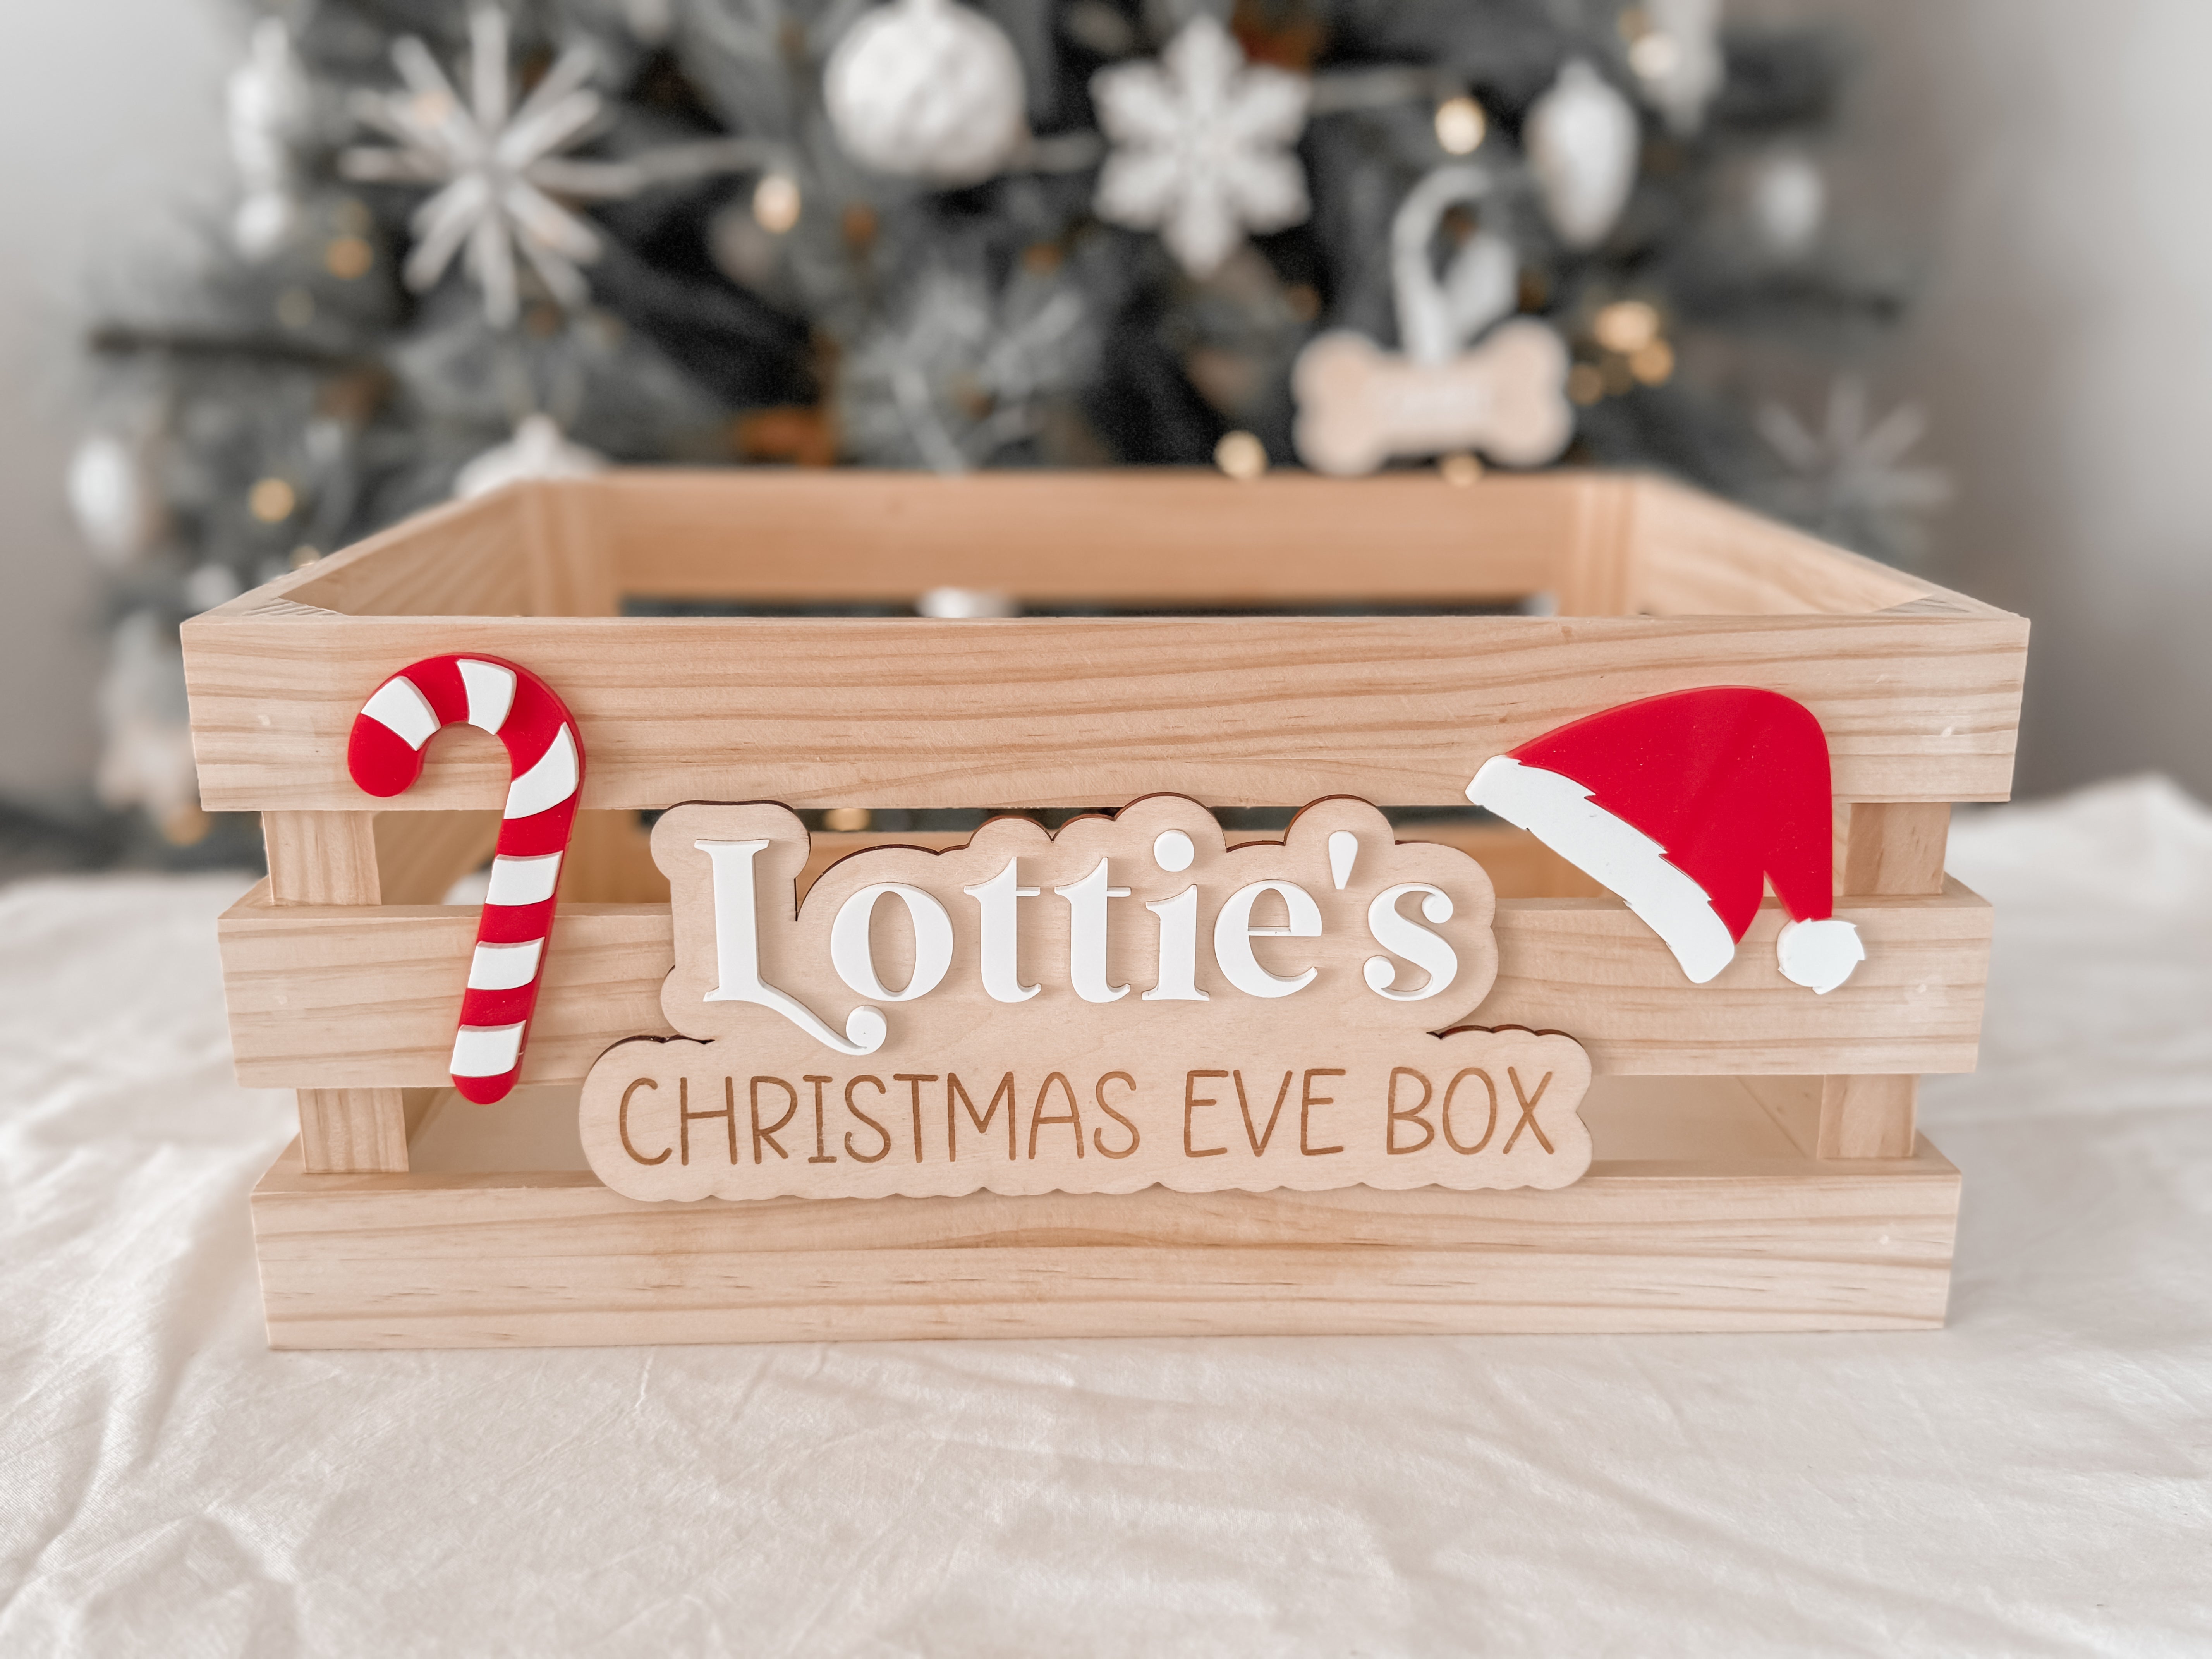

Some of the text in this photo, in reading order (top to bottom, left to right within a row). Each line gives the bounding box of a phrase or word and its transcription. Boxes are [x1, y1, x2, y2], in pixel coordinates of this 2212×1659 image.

[694, 830, 1458, 1055] Lottie's
[619, 1066, 1554, 1165] CHRISTMAS EVE BOX
